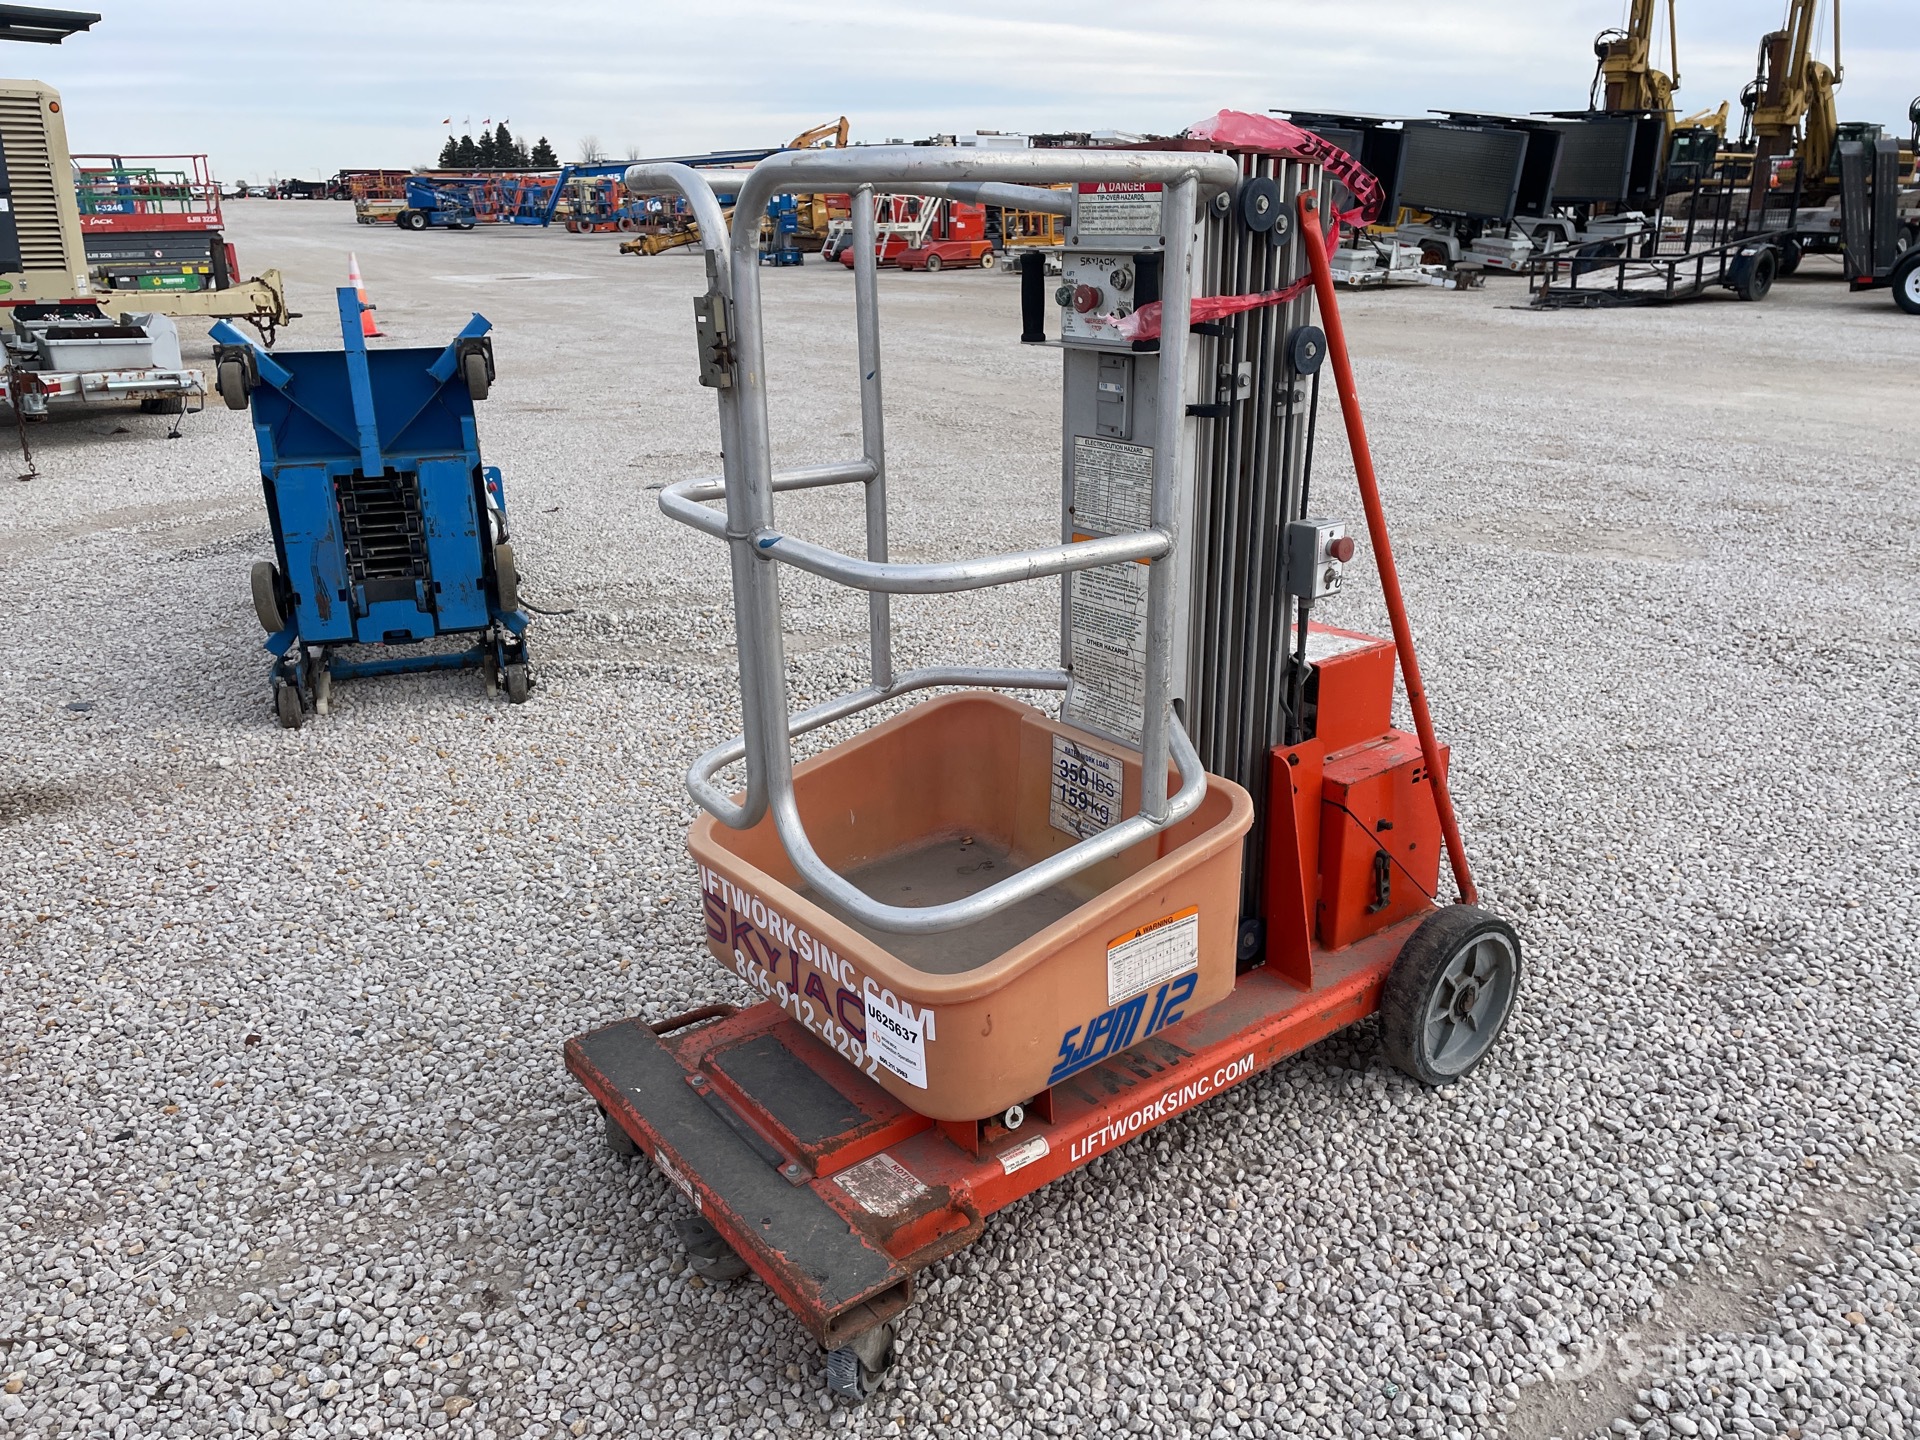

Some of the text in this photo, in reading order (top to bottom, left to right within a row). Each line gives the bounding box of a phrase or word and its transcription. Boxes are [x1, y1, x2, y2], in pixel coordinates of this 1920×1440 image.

[1109, 182, 1146, 192] DANGER
[1080, 256, 1116, 266] SKYJACK
[1084, 317, 1107, 325] EMERGENC
[1084, 439, 1143, 454] ELECTROCUTION HAZARD
[1086, 638, 1129, 657] OTHER HAZARDS
[1060, 759, 1114, 798] 350 lbs
[1095, 759, 1110, 770] LOAD
[1060, 784, 1088, 810] 159
[1091, 796, 1109, 825] kg
[1143, 917, 1173, 934] WARNING
[700, 864, 936, 1042] IFTWORKSINC.COM
[702, 889, 867, 1044] SKYJAC
[734, 948, 882, 1084] 866-912-4292
[868, 1003, 918, 1044] U625637
[1047, 972, 1199, 1082] SJPM 12
[1070, 1053, 1255, 1162] LIFTWORKSINC.COM
[891, 1164, 920, 1187] NOTICE
